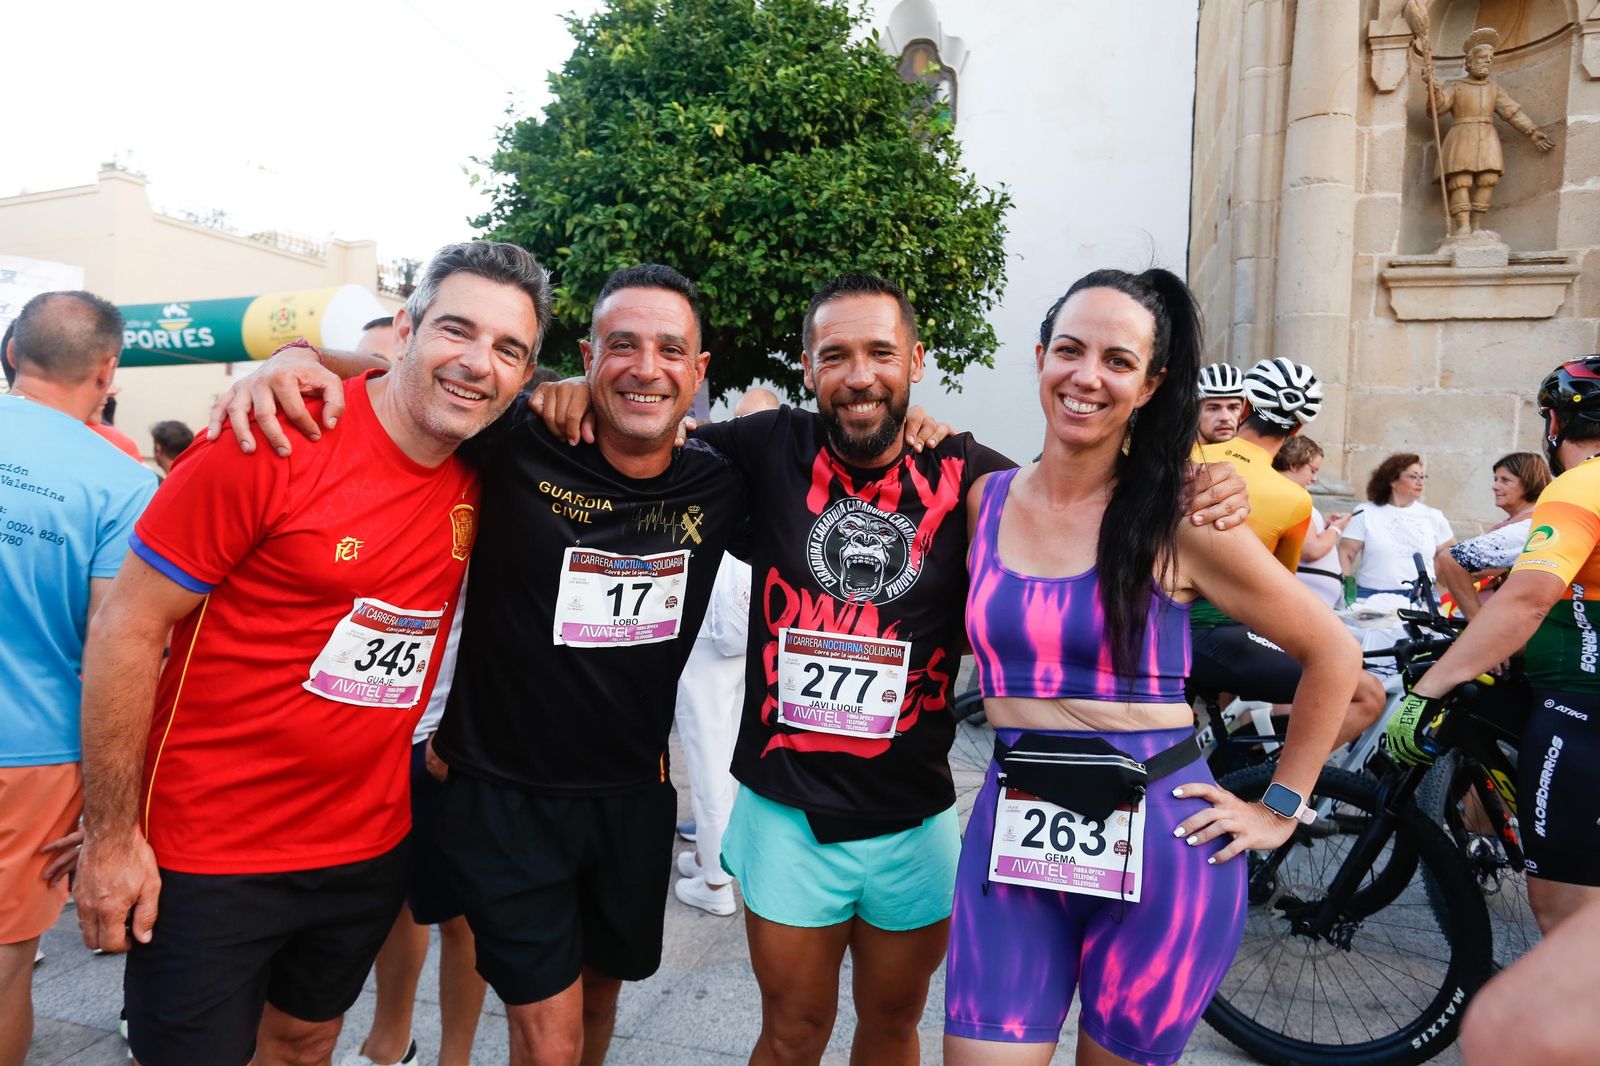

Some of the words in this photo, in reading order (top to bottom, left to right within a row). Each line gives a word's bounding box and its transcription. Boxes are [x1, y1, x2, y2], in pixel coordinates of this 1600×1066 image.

[2, 475, 65, 502] Valentina
[538, 480, 613, 511] GUARDIA
[551, 503, 592, 524] CIVIL
[846, 500, 890, 520] CARADURA
[6, 520, 35, 536] 0024
[39, 529, 65, 546] 8219
[811, 502, 847, 543] CARADURA
[0, 532, 23, 547] 780
[580, 554, 614, 569] CARRERA
[613, 558, 653, 571] NOCTURNA
[652, 558, 683, 570] SOLIDARIA
[810, 541, 838, 588] CARADURA
[606, 582, 653, 617] 17
[366, 607, 399, 626] CARRERA
[613, 618, 639, 626] LOBO
[579, 624, 631, 638] AVATEL
[354, 638, 421, 677] 345
[787, 635, 793, 644] VI
[793, 636, 822, 649] CARRERA
[822, 639, 863, 653] NOCTURNA
[863, 644, 903, 659] SOLIDARIA
[330, 678, 381, 698] AVATEL
[366, 675, 395, 686] GUAJE
[800, 662, 879, 704] 277
[793, 706, 842, 725] AVATEL
[809, 700, 829, 709] JAVI
[831, 703, 863, 714] LUQUE
[1554, 704, 1588, 721] ATIKA
[1021, 808, 1106, 856] 263
[1011, 858, 1068, 879] AVATEL
[1045, 852, 1076, 865] GEMA
[1411, 986, 1465, 1049] MAXXIS
